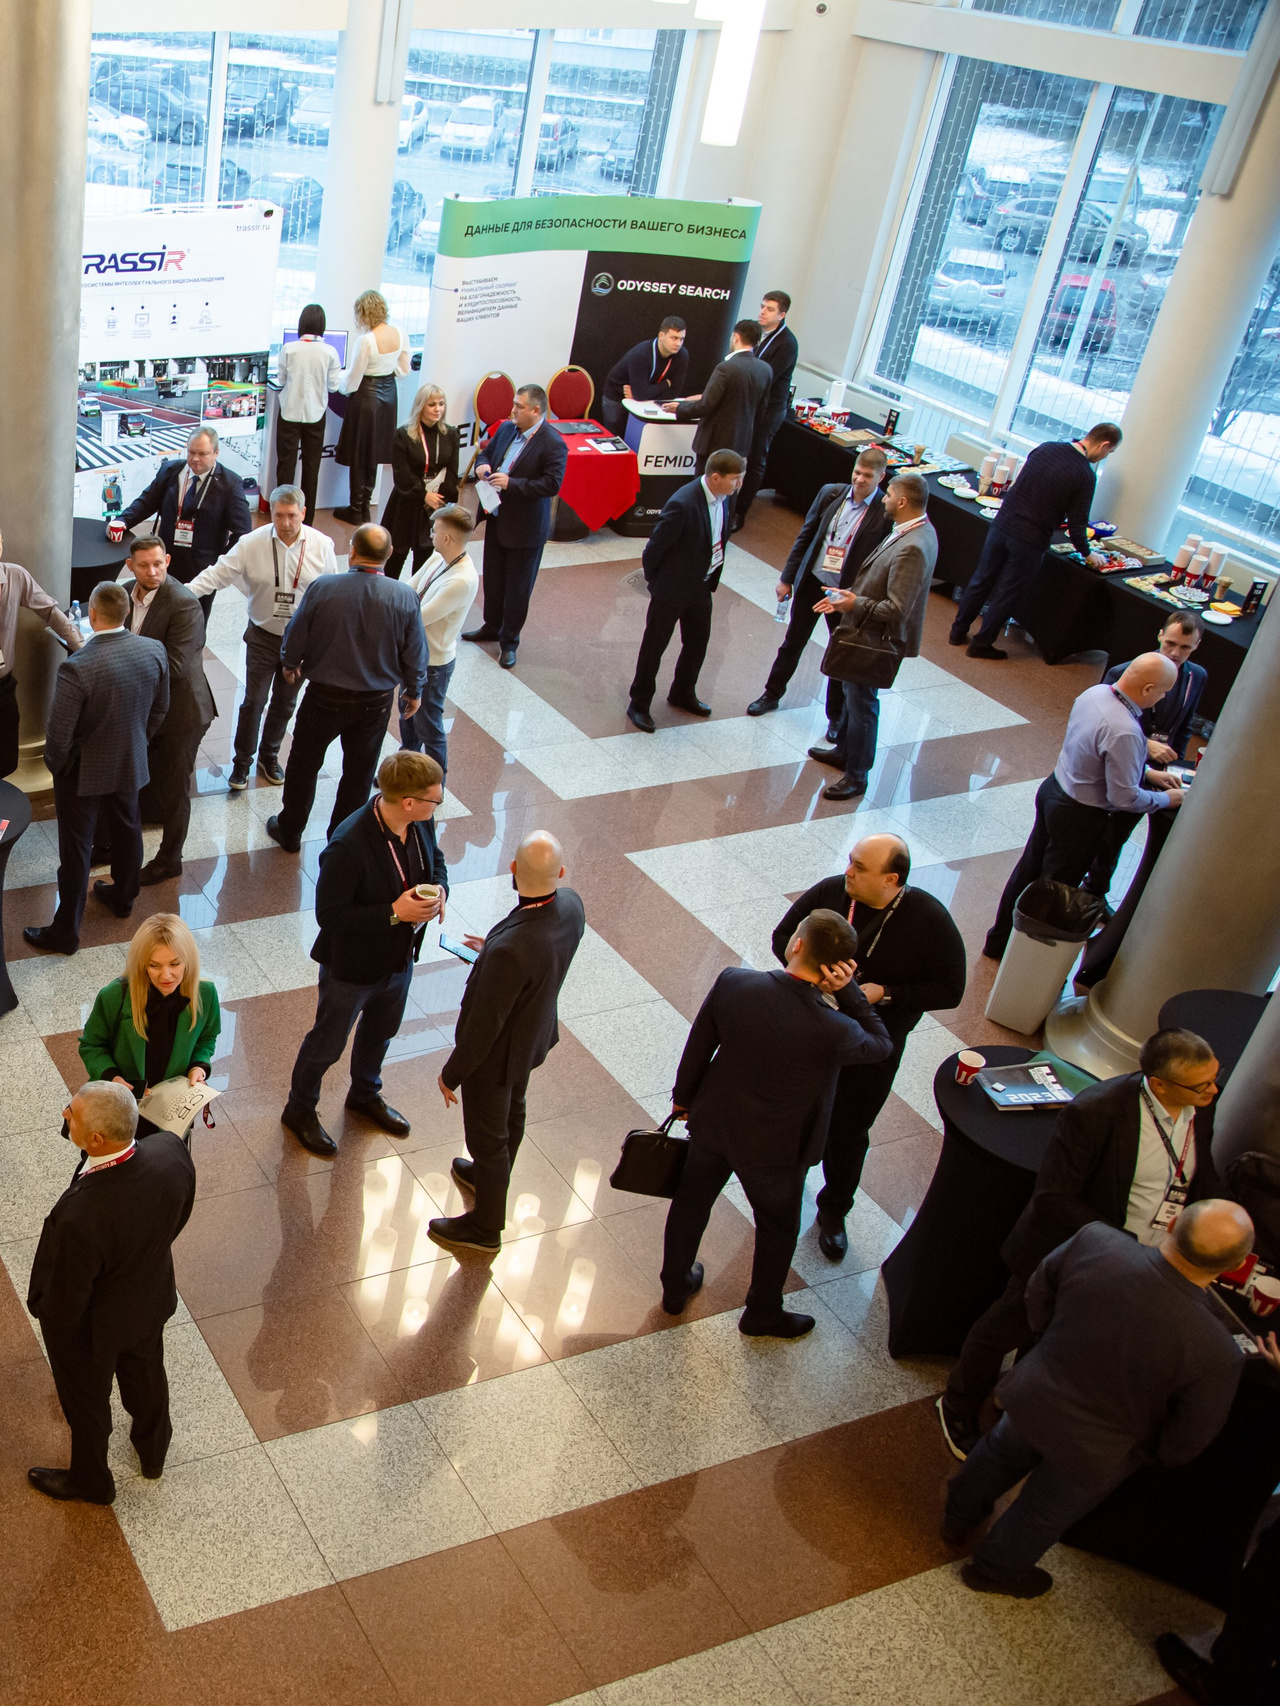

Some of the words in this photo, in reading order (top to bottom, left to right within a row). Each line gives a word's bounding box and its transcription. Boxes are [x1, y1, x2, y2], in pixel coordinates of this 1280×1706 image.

[236, 224, 270, 232] trassir.ru
[464, 222, 510, 237] ДАННЫЕ
[511, 220, 533, 234] ДЛЯ
[535, 218, 627, 230] БЕЗОПАСНОСТИ
[630, 220, 684, 232] ВАШЕГО
[687, 224, 747, 239] БИЗНЕСА
[82, 245, 186, 275] RASSIR
[617, 280, 676, 294] ODYSSEY
[678, 284, 731, 300] SEARCH
[643, 454, 696, 468] FEMID
[1006, 1092, 1057, 1102] 2023
